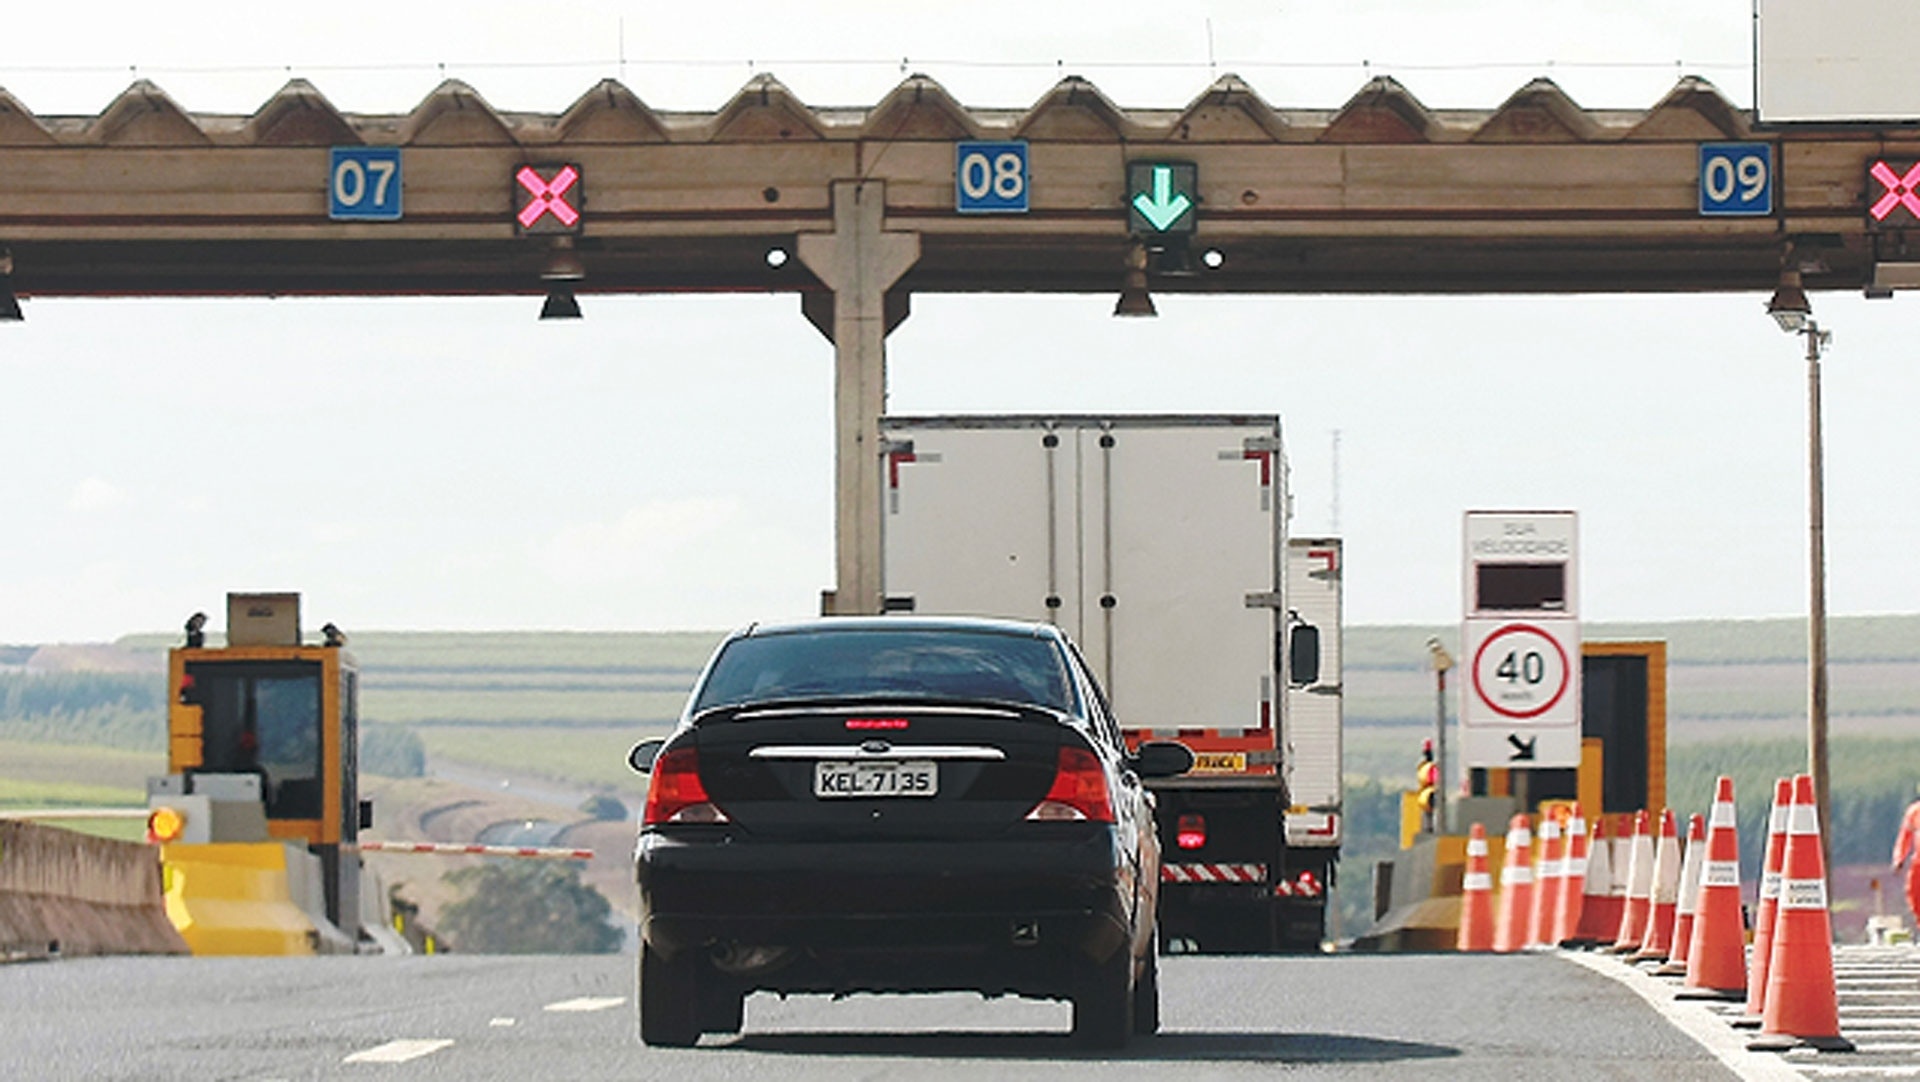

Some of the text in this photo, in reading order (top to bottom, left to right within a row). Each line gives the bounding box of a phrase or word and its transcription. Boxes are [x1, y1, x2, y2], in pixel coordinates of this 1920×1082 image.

[335, 160, 395, 206] 07
[962, 153, 1023, 199] 08
[1705, 156, 1766, 202] 09
[1496, 651, 1544, 684] 40
[821, 773, 930, 792] KEL-7135
